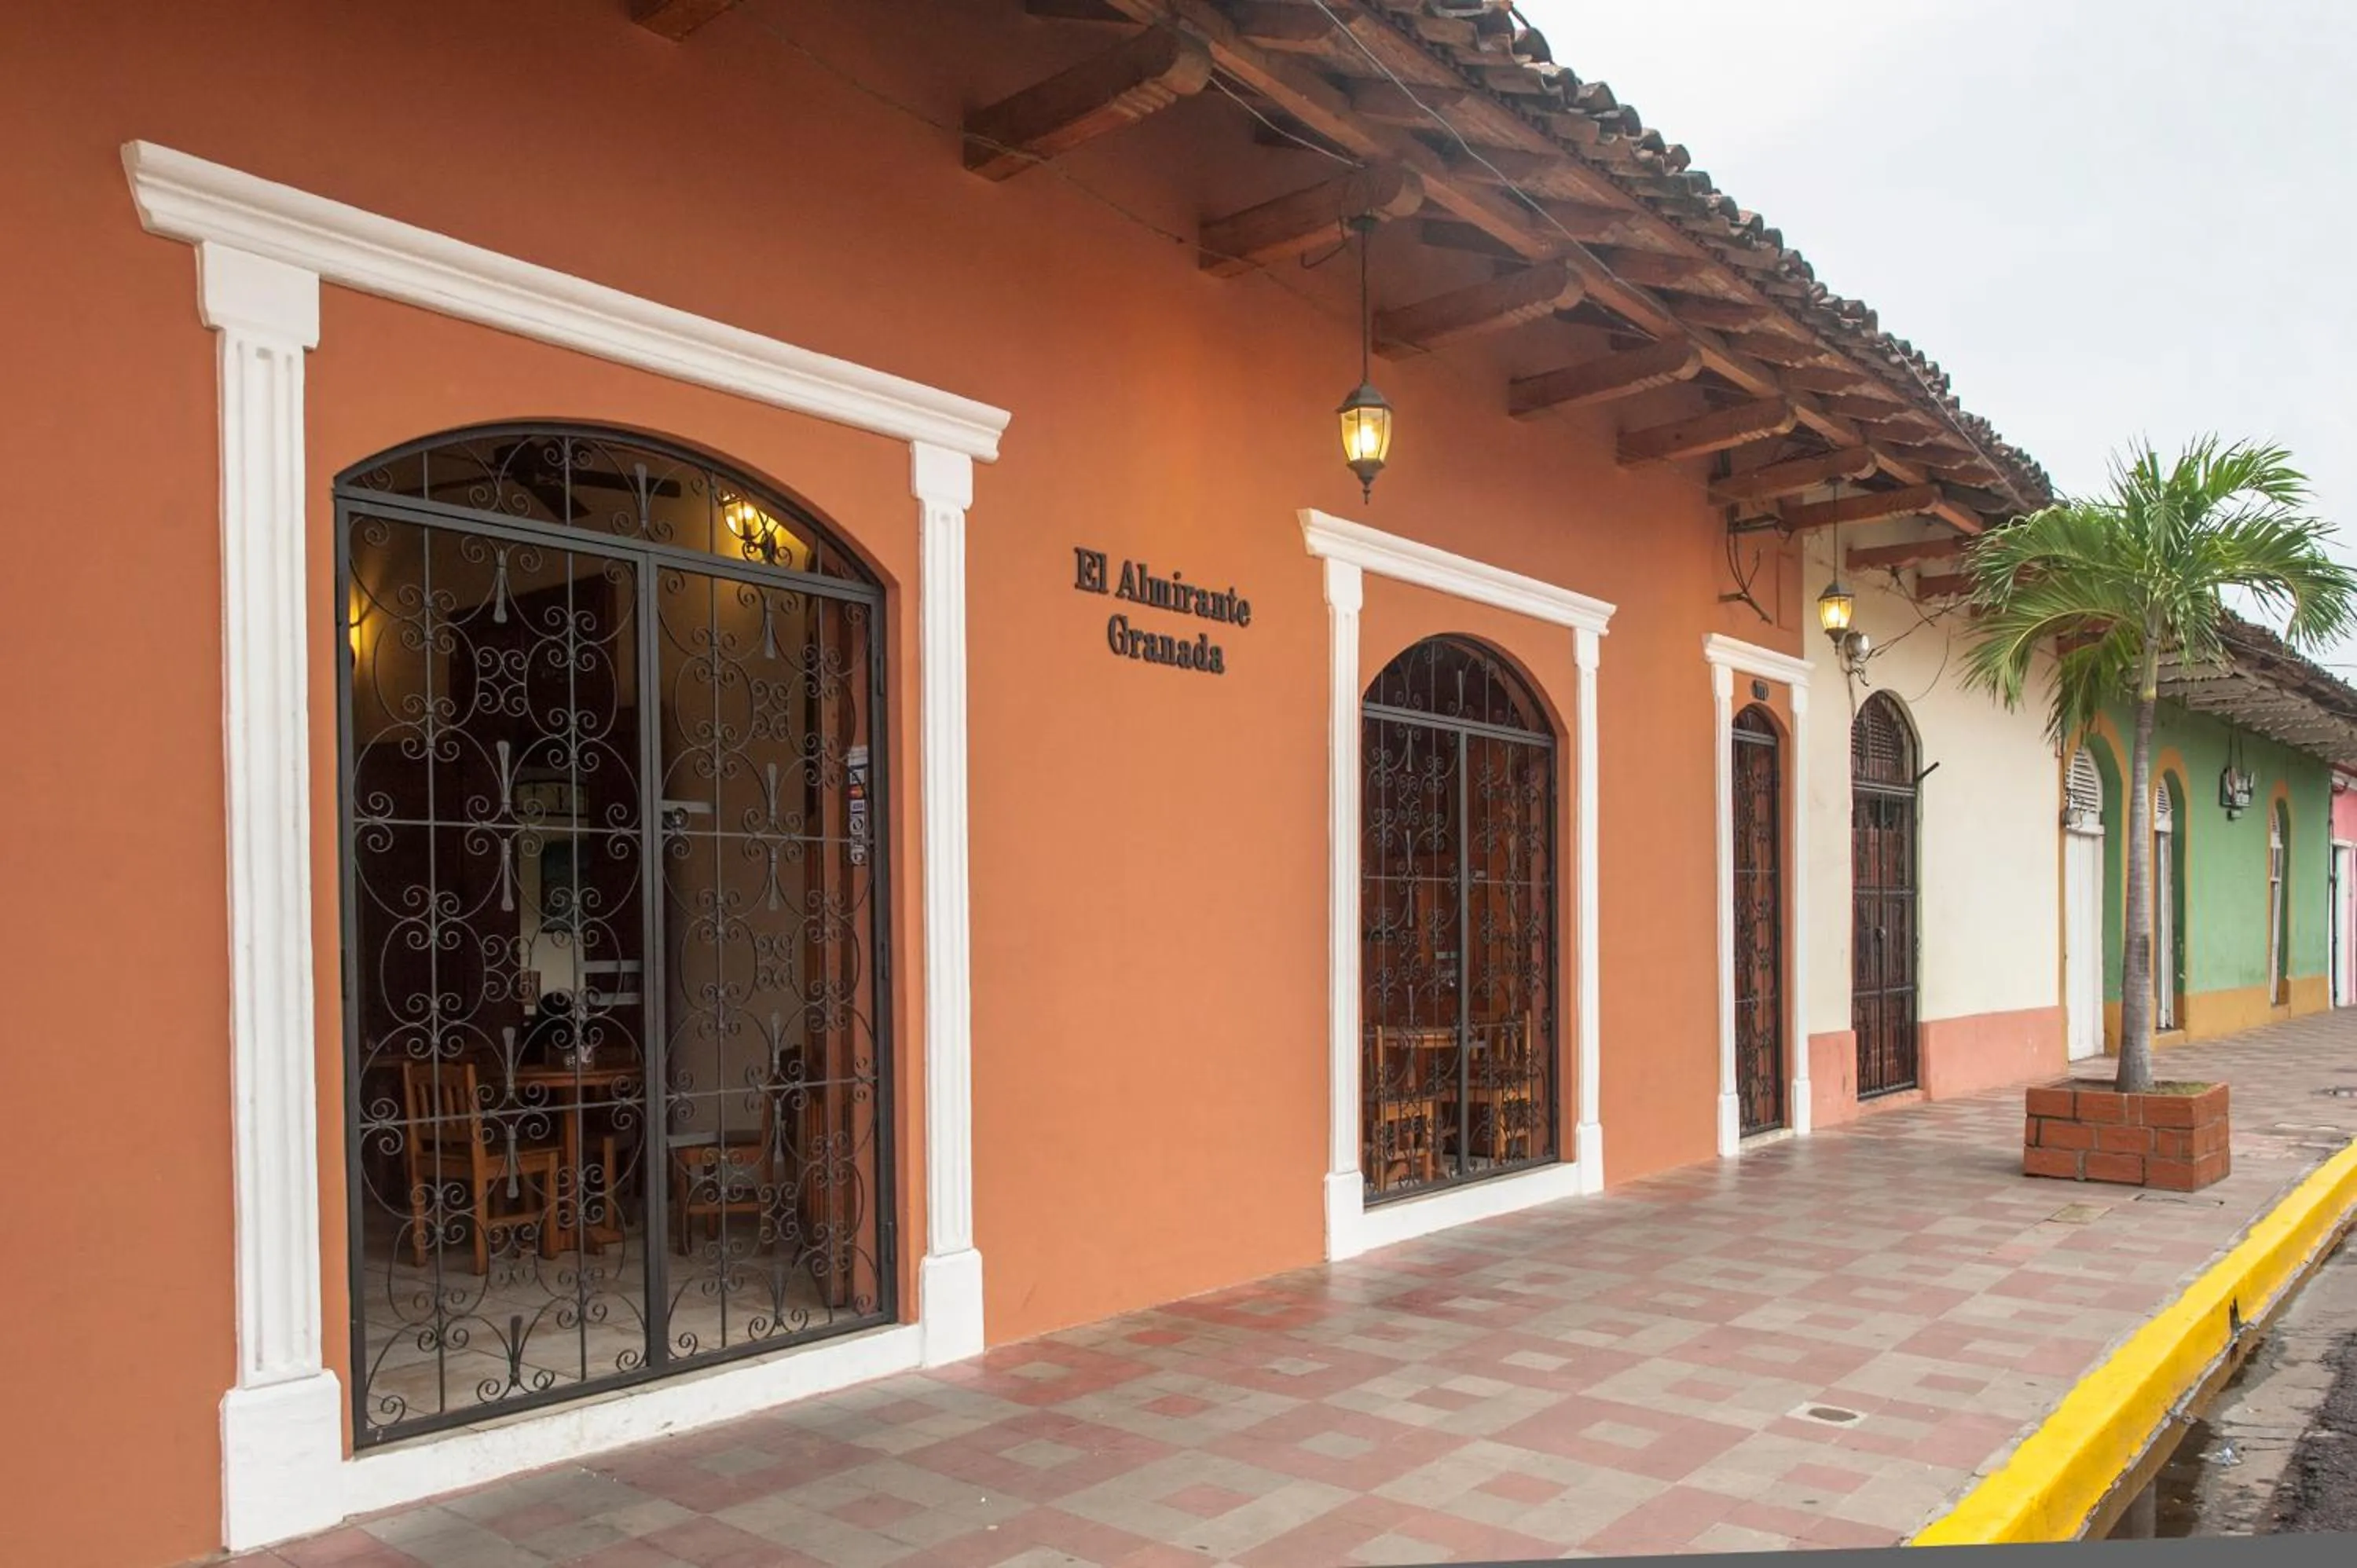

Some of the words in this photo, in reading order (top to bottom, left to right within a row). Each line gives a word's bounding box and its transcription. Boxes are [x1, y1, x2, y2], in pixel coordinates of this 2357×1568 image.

[1074, 547, 1109, 595] El
[1115, 559, 1251, 628] Almirante
[1107, 614, 1224, 674] Granada
